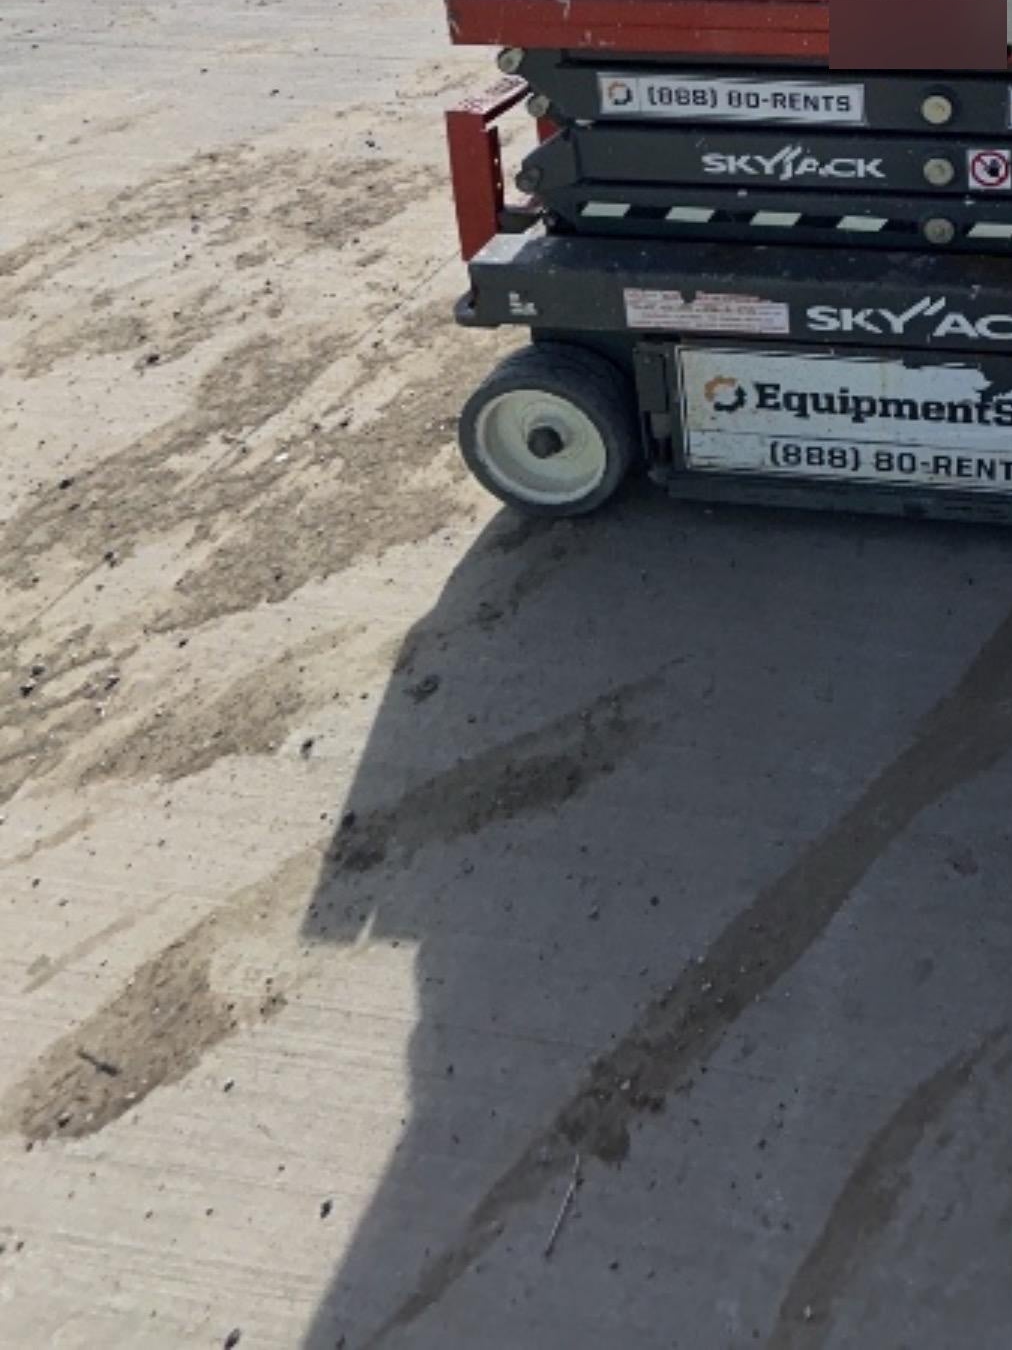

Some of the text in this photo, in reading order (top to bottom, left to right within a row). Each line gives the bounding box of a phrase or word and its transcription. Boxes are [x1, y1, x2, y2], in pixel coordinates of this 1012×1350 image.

[647, 86, 851, 112] (888) 80-RENTS
[701, 146, 886, 181] SKYJACK
[769, 442, 862, 471] (888)
